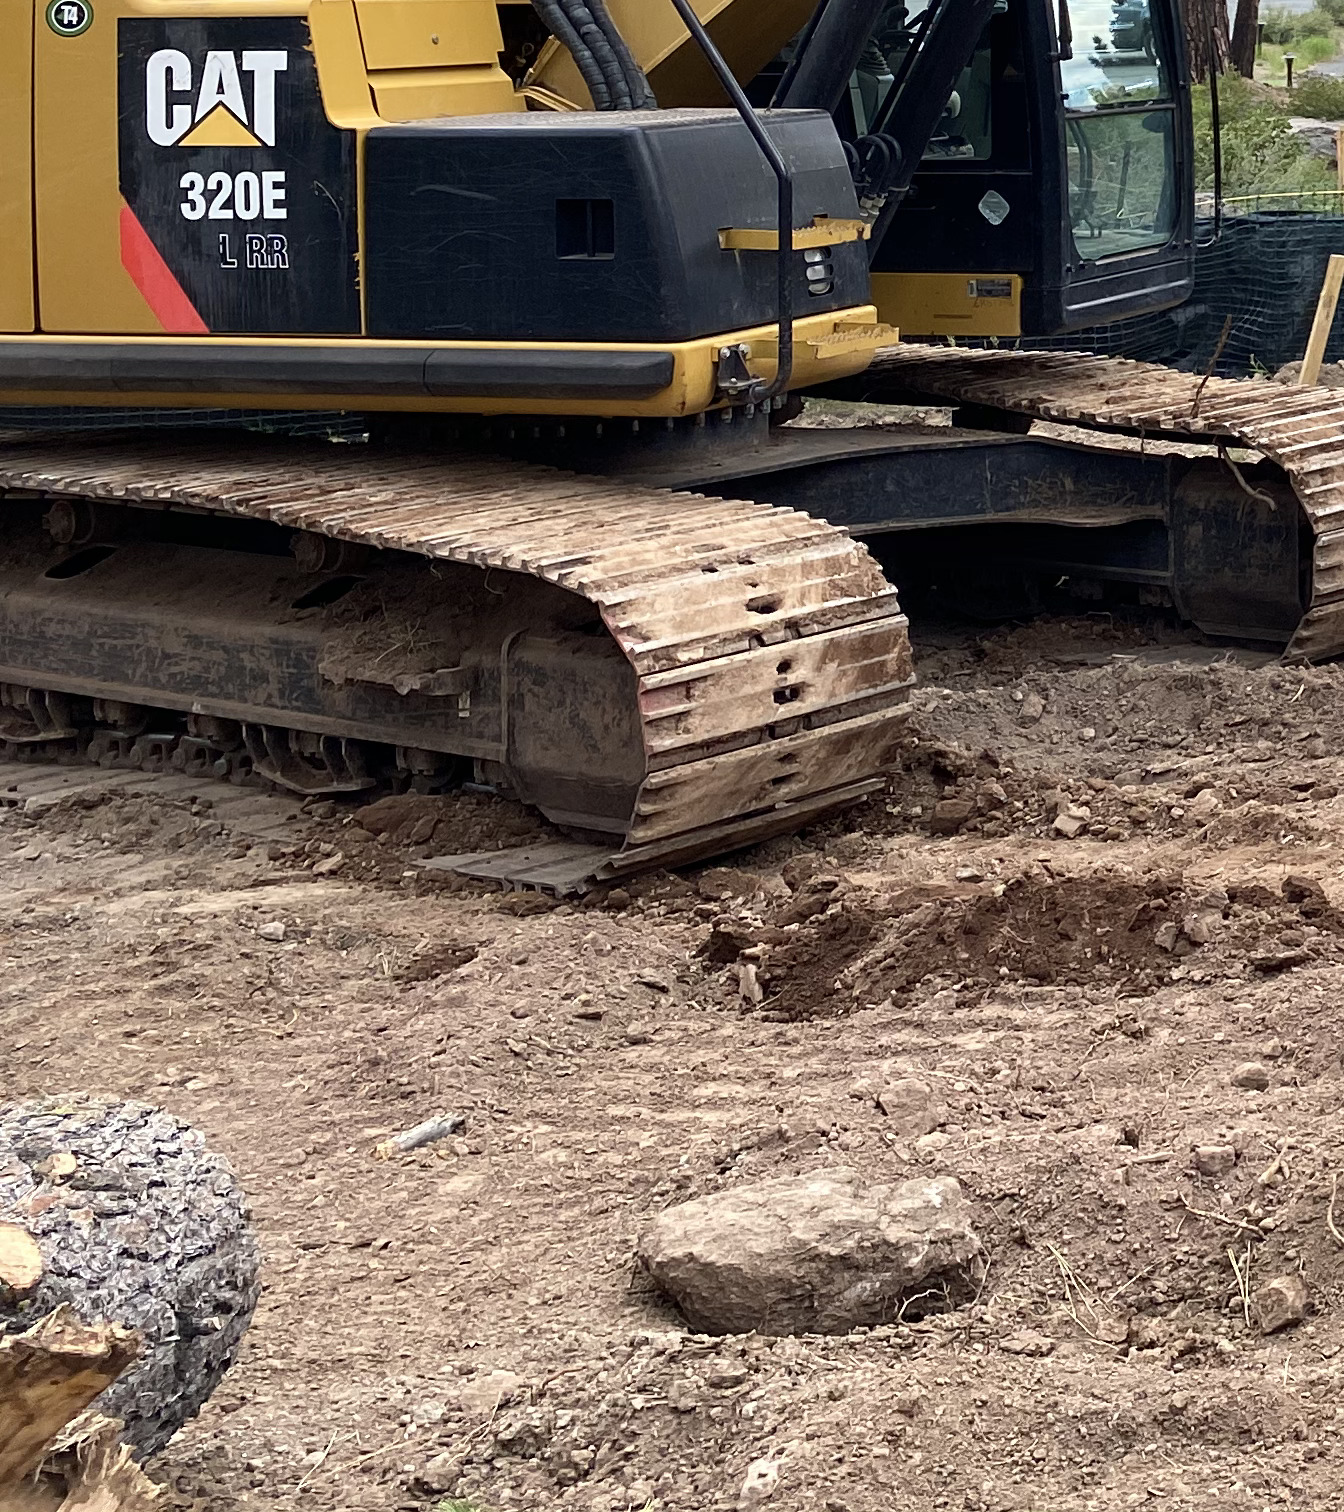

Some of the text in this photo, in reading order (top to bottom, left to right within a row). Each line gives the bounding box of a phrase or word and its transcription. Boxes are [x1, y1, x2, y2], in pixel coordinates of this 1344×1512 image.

[60, 5, 79, 25] T4
[146, 48, 288, 147] CAT
[179, 171, 288, 221] 320E
[218, 234, 289, 269] L RR
